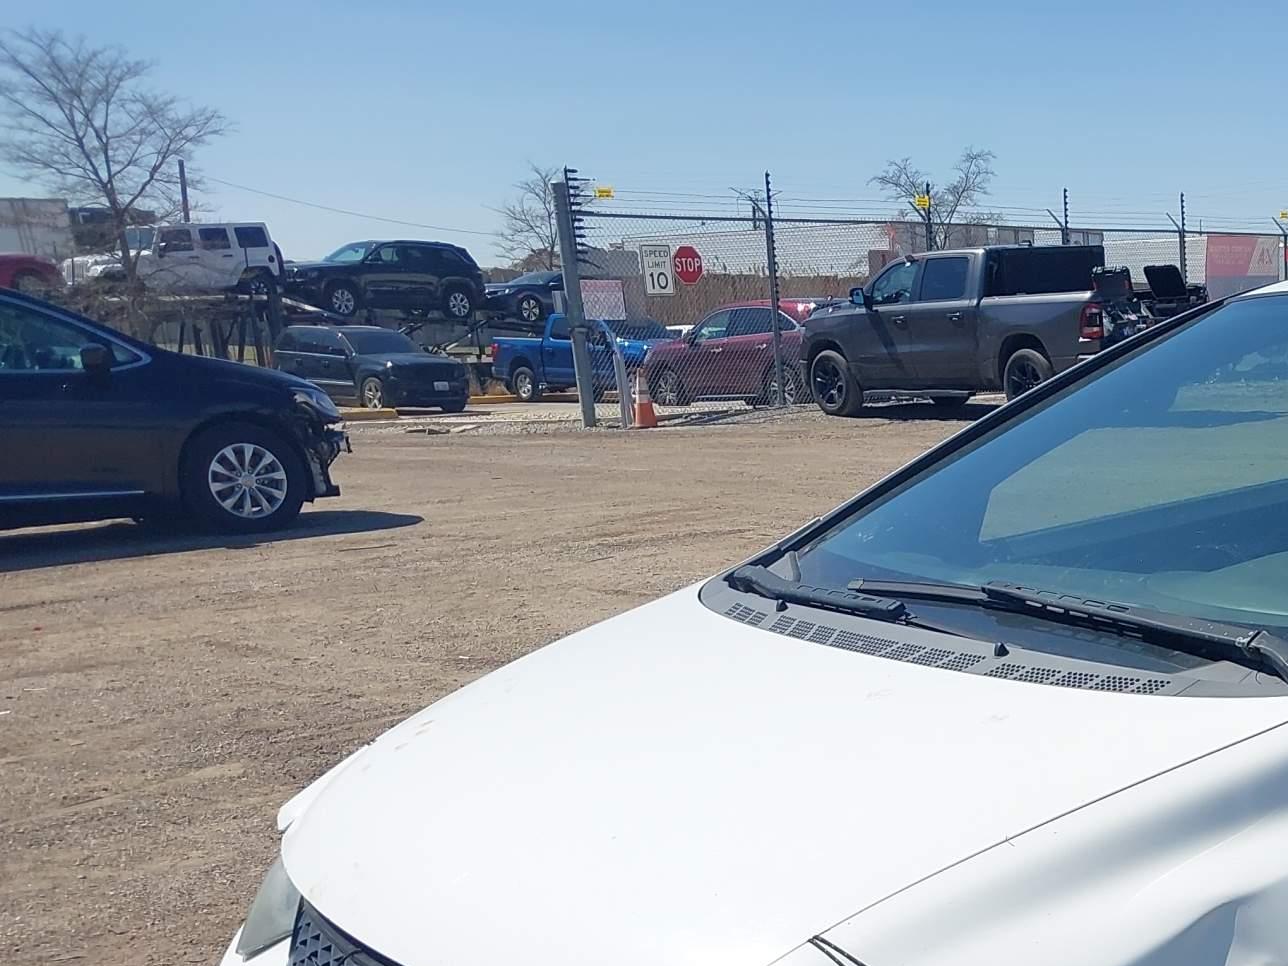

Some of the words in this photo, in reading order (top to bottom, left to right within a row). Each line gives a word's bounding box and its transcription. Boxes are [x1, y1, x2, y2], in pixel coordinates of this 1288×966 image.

[644, 250, 668, 258] SPEED
[647, 261, 666, 269] LIMIT
[675, 257, 701, 272] STOP
[649, 271, 669, 290] 10
